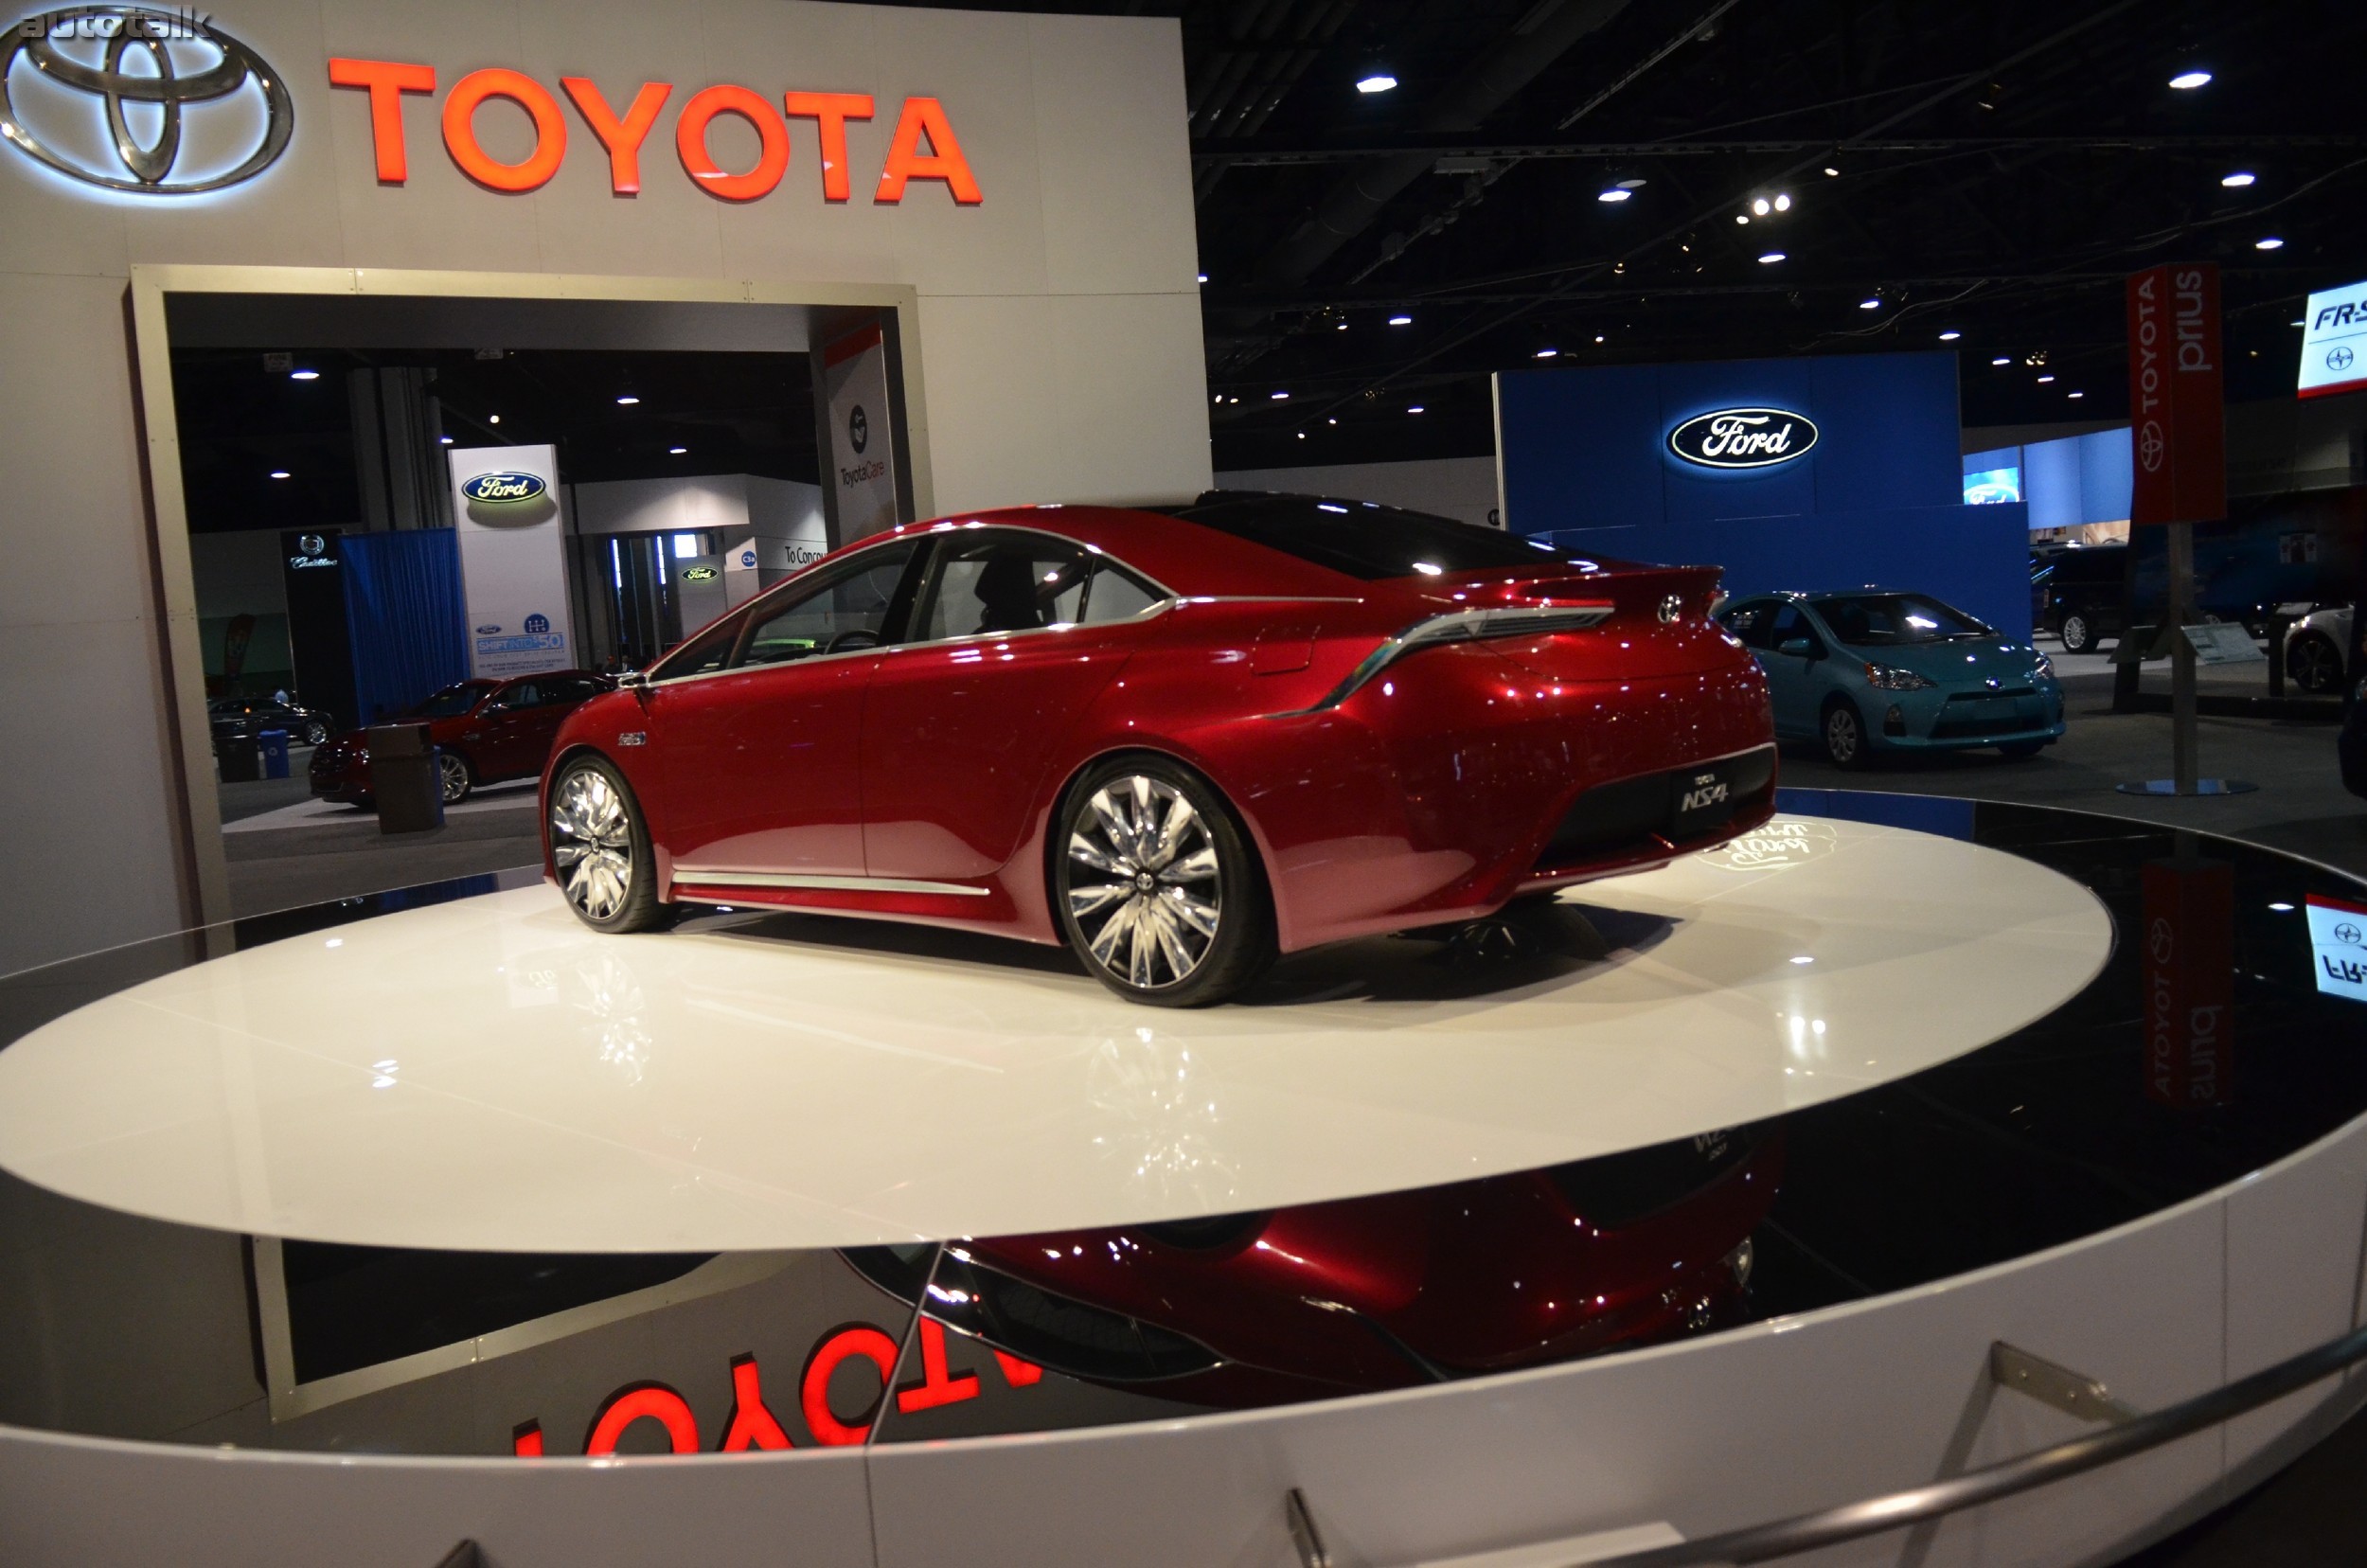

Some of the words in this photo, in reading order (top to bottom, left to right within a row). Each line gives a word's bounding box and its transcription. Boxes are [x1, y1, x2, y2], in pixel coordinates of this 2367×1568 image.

[329, 57, 984, 206] TOYOTA
[2176, 270, 2214, 373] prius
[2138, 275, 2160, 415] TOYOTA
[1702, 415, 1791, 457] Ford
[477, 476, 528, 498] Ford
[841, 460, 884, 489] ToyotaCare
[290, 556, 339, 569] Cadillac
[785, 545, 796, 563] To
[687, 568, 712, 579] Ford
[478, 640, 508, 651] SHIFT
[1681, 784, 1729, 811] NS4
